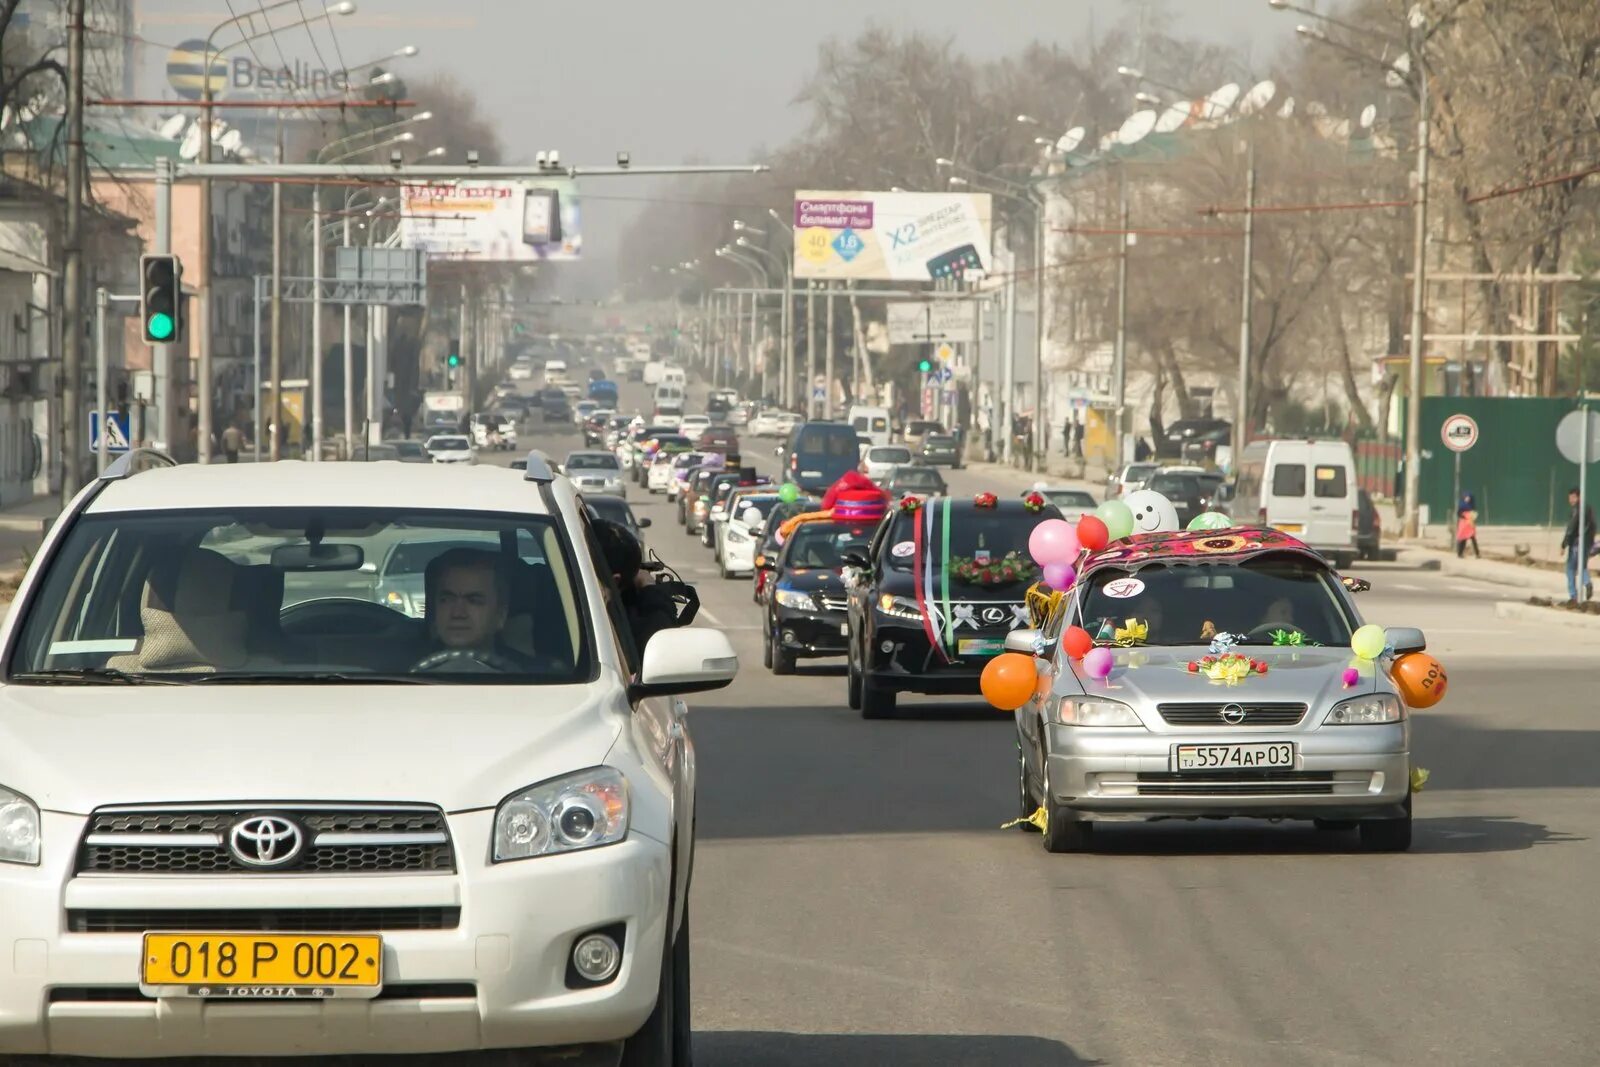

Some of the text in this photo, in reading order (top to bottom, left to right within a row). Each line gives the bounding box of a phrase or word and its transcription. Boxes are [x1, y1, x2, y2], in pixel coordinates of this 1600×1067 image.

[233, 56, 347, 90] Beeline
[1422, 662, 1440, 688] YOU
[1183, 759, 1194, 767] TJ
[170, 941, 360, 979] 018 P 002
[226, 986, 297, 997] TOYOTA
